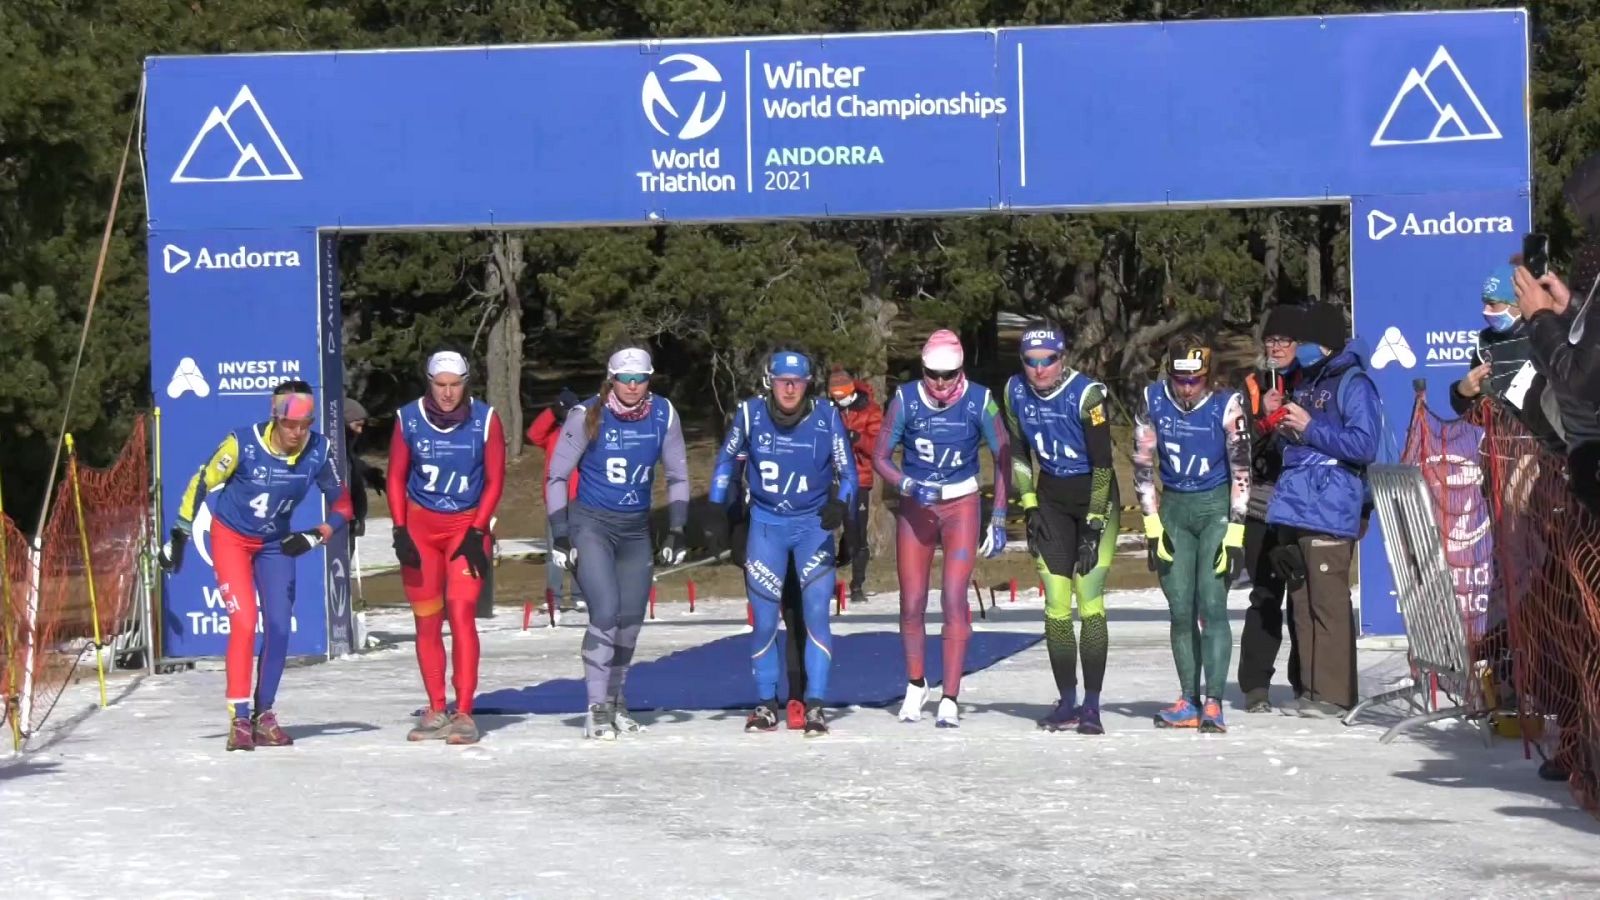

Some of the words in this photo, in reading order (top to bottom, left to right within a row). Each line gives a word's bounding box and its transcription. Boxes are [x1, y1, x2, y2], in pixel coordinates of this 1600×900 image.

[763, 61, 865, 89] Winter
[763, 95, 832, 119] World
[836, 91, 1008, 120] Championships
[652, 147, 720, 169] World
[764, 145, 884, 167] ANDORRA
[636, 171, 736, 193] Triathlon
[764, 171, 811, 191] 2021
[1400, 211, 1514, 236] Andorra
[194, 246, 301, 269] Andorra
[1426, 330, 1480, 345] INVES
[1426, 346, 1476, 360] ANDO
[218, 361, 277, 374] INVEST
[282, 360, 300, 372] IN
[914, 437, 963, 468] 9/A
[421, 464, 470, 494] 7/A
[606, 457, 650, 485] 6/A
[759, 460, 809, 495] 2/A
